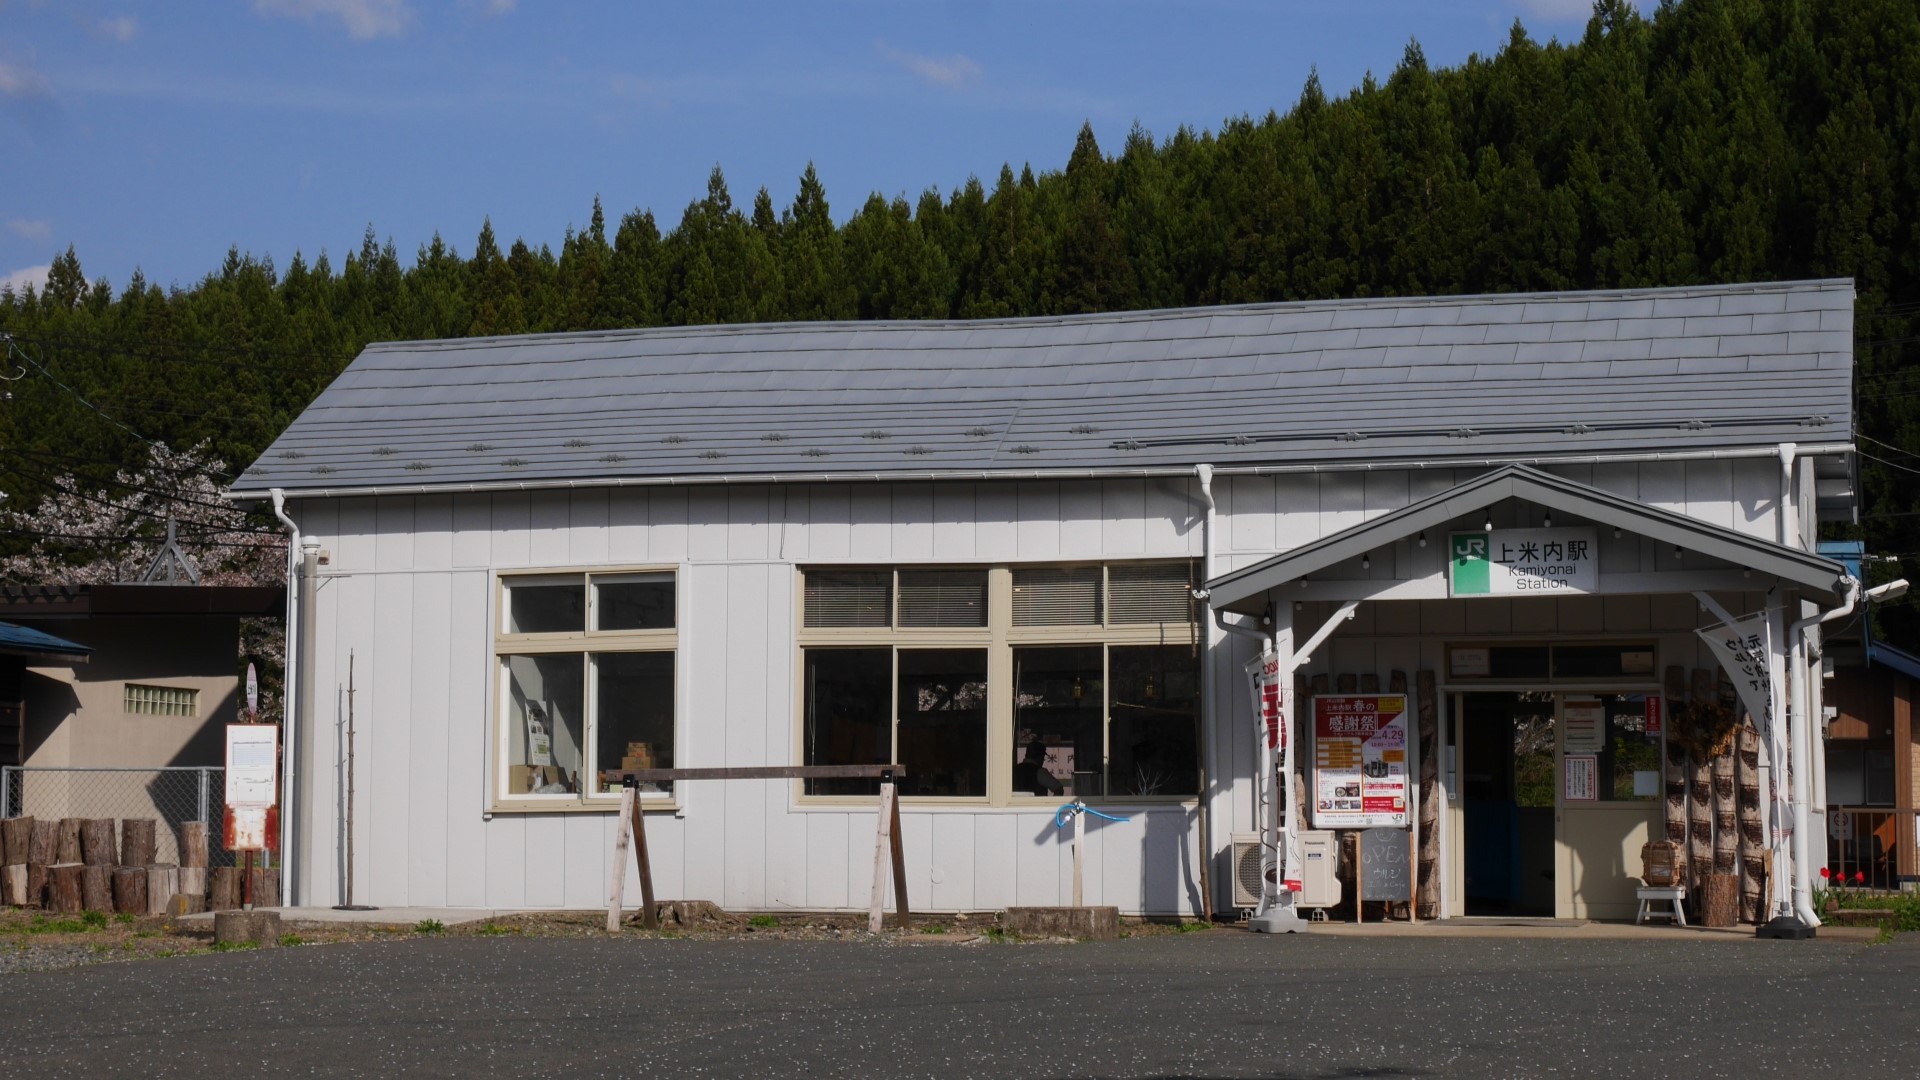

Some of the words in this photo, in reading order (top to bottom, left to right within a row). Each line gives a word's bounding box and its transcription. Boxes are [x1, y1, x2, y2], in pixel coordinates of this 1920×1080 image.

[1456, 538, 1485, 555] JR
[1494, 540, 1588, 563] 上米内駅
[1509, 563, 1576, 577] Kamiyonai
[1517, 577, 1568, 590] Station
[1353, 699, 1375, 712] 春の
[1328, 715, 1375, 731] 感謝祭
[1382, 730, 1404, 739] 4.29
